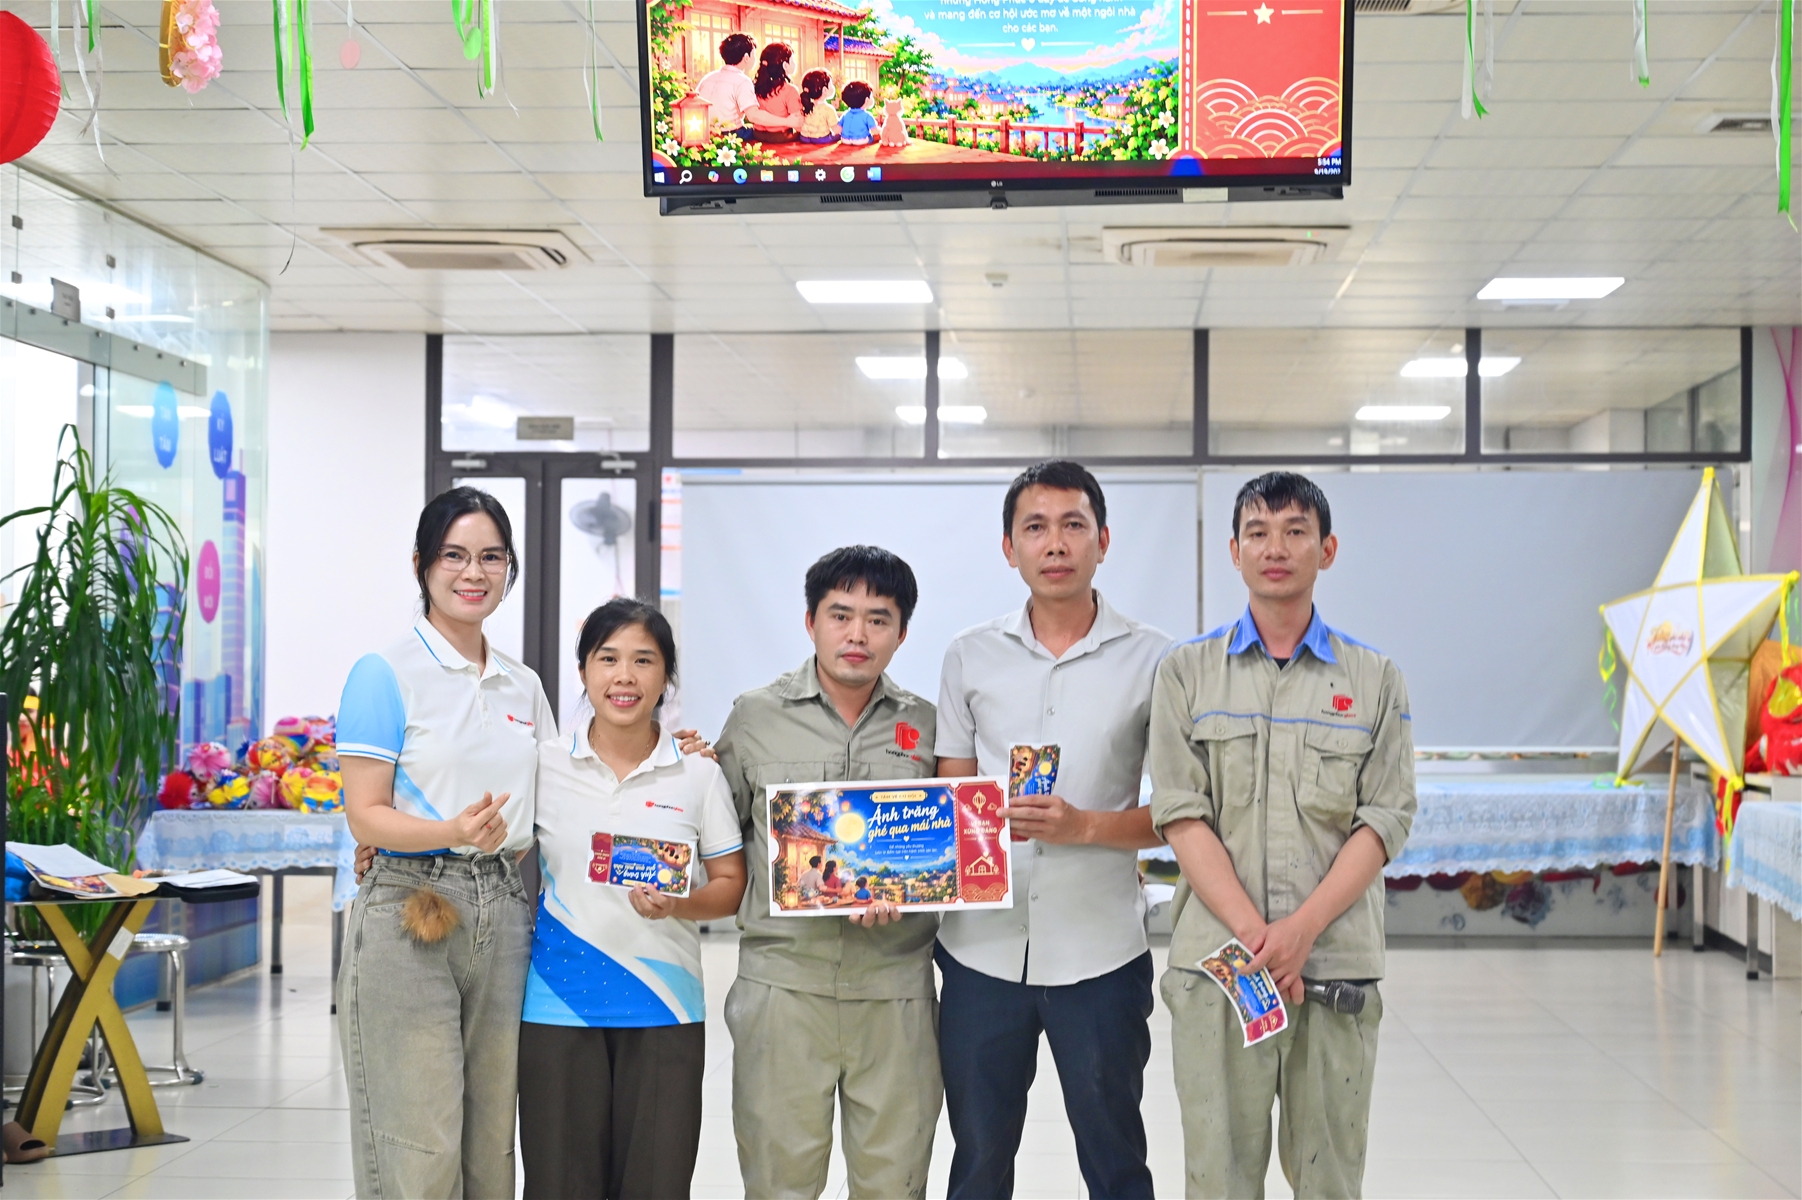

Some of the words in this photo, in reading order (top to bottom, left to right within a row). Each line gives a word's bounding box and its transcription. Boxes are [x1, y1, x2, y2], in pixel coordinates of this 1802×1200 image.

[924, 9, 935, 20] và
[938, 11, 965, 22] mang
[968, 8, 986, 19] đến
[989, 10, 1000, 19] cơ
[1003, 8, 1017, 20] hội
[1020, 8, 1038, 19] ước
[1041, 9, 1056, 18] mơ
[1072, 6, 1092, 19] một
[1094, 6, 1115, 20] ngôi
[1118, 6, 1136, 17] nhà
[1002, 22, 1019, 33] cho
[1022, 22, 1037, 33] các
[1039, 22, 1058, 34] bạn.
[1331, 157, 1342, 166] PM
[867, 804, 899, 828] Ánh
[902, 804, 939, 820] trăng
[868, 824, 888, 843] ghé
[889, 824, 909, 839] qua
[911, 818, 930, 833] mái
[931, 815, 952, 830] nhà
